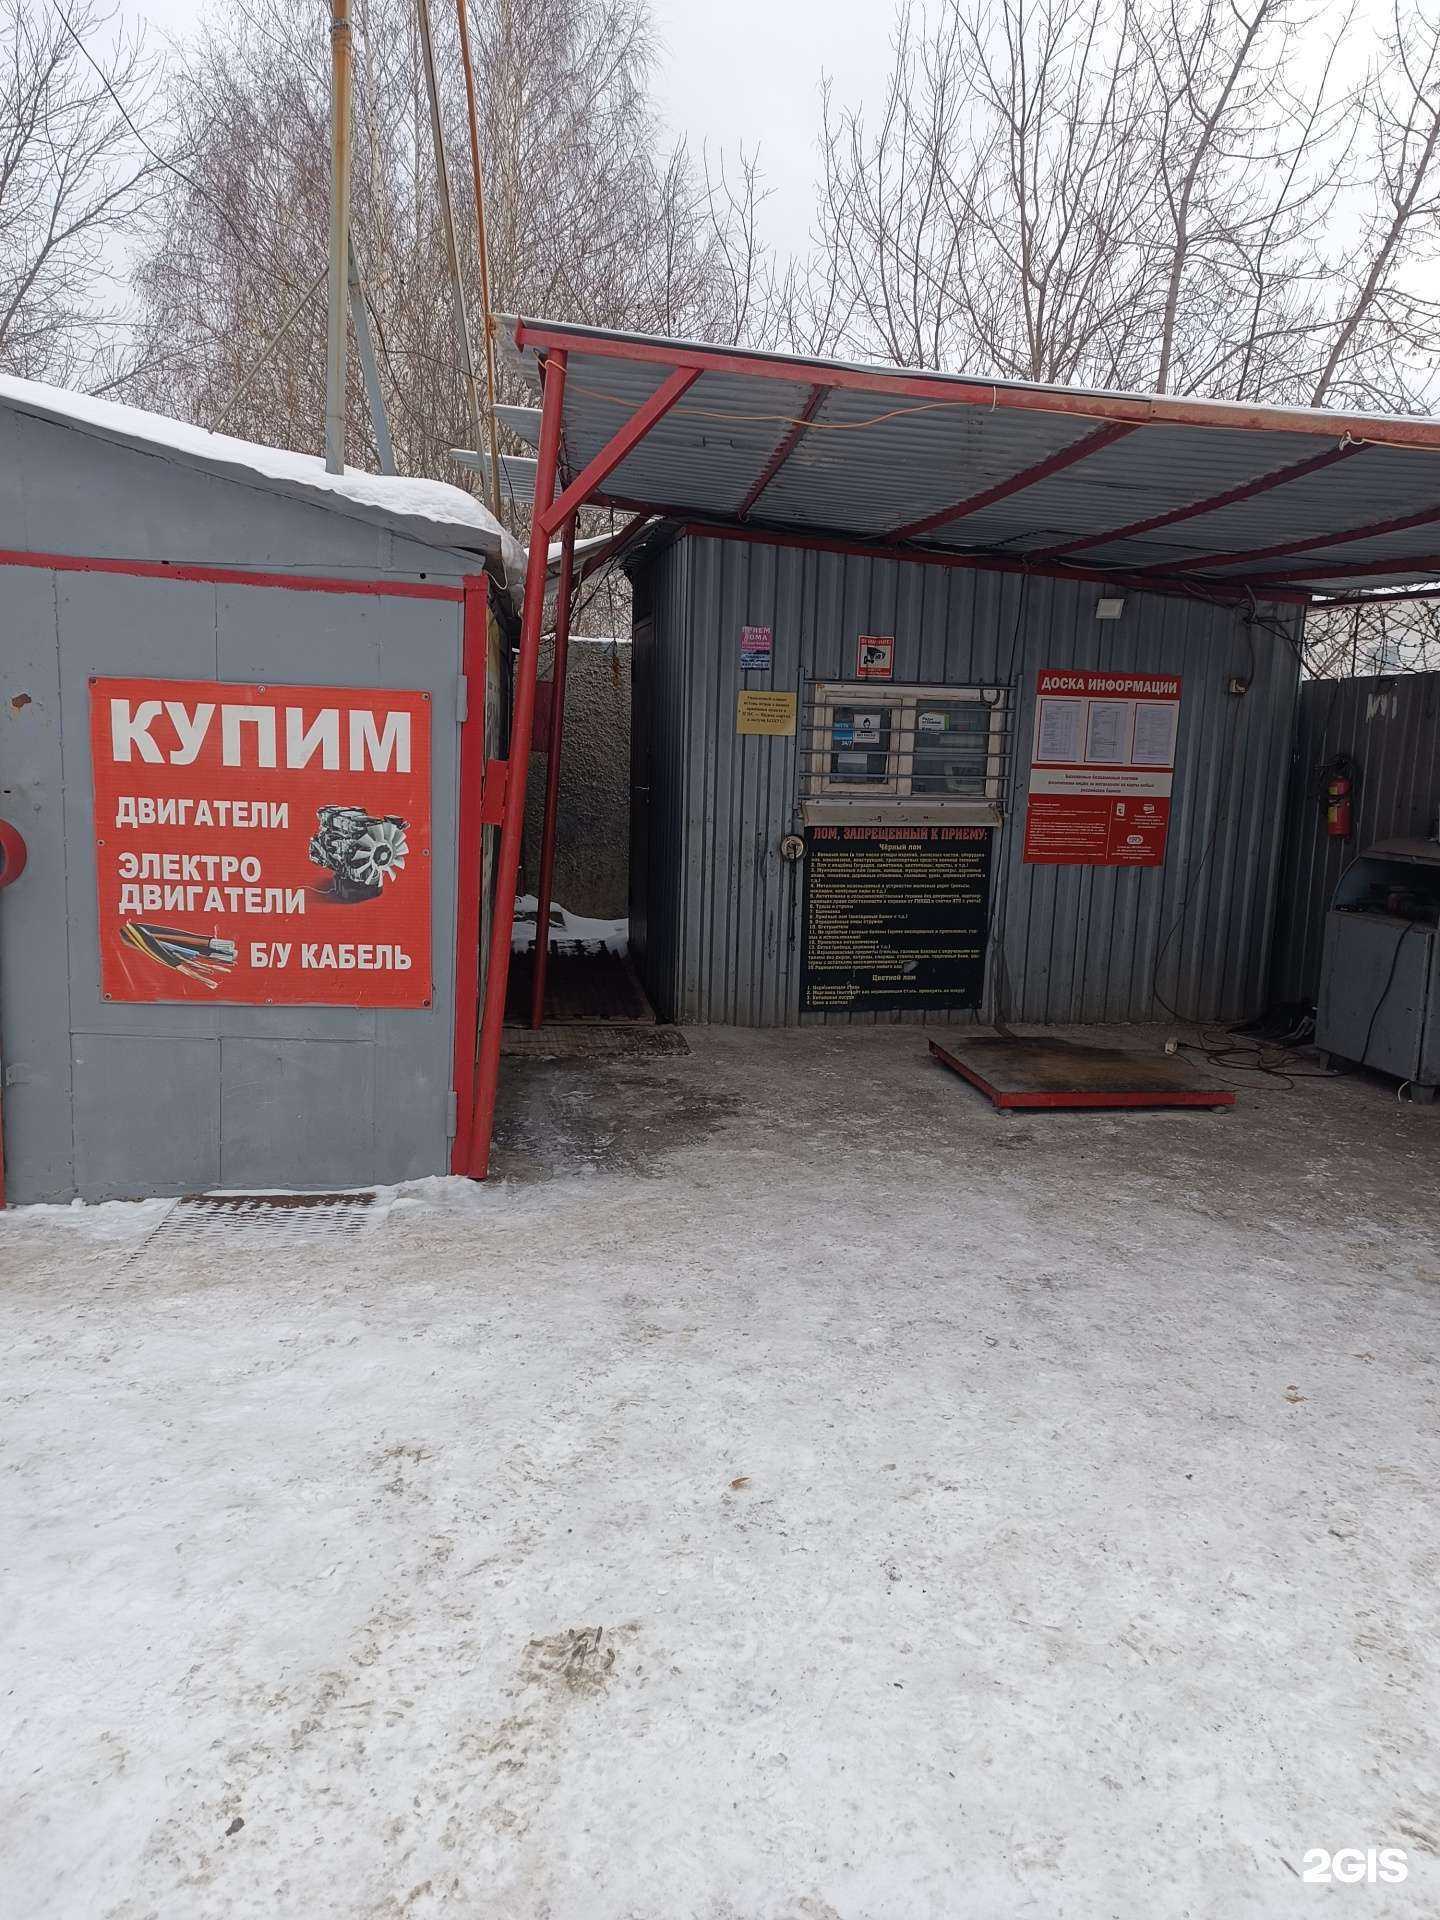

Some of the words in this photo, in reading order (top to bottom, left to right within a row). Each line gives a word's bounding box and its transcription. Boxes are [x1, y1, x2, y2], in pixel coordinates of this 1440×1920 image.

[1041, 677, 1084, 691] ДОСКА
[1088, 678, 1177, 695] ИНФОРМАЦИИ
[110, 698, 412, 774] КУПИМ
[115, 796, 289, 829] ДВИГАТЕЛИ
[813, 827, 841, 841] ЛОМ,
[931, 828, 939, 840] К
[118, 852, 262, 883] ЭЛЕКТРО
[118, 884, 306, 915] ДВИГАТЕЛИ
[250, 942, 292, 970] Б/У
[301, 943, 412, 970] КАБЕЛЬ
